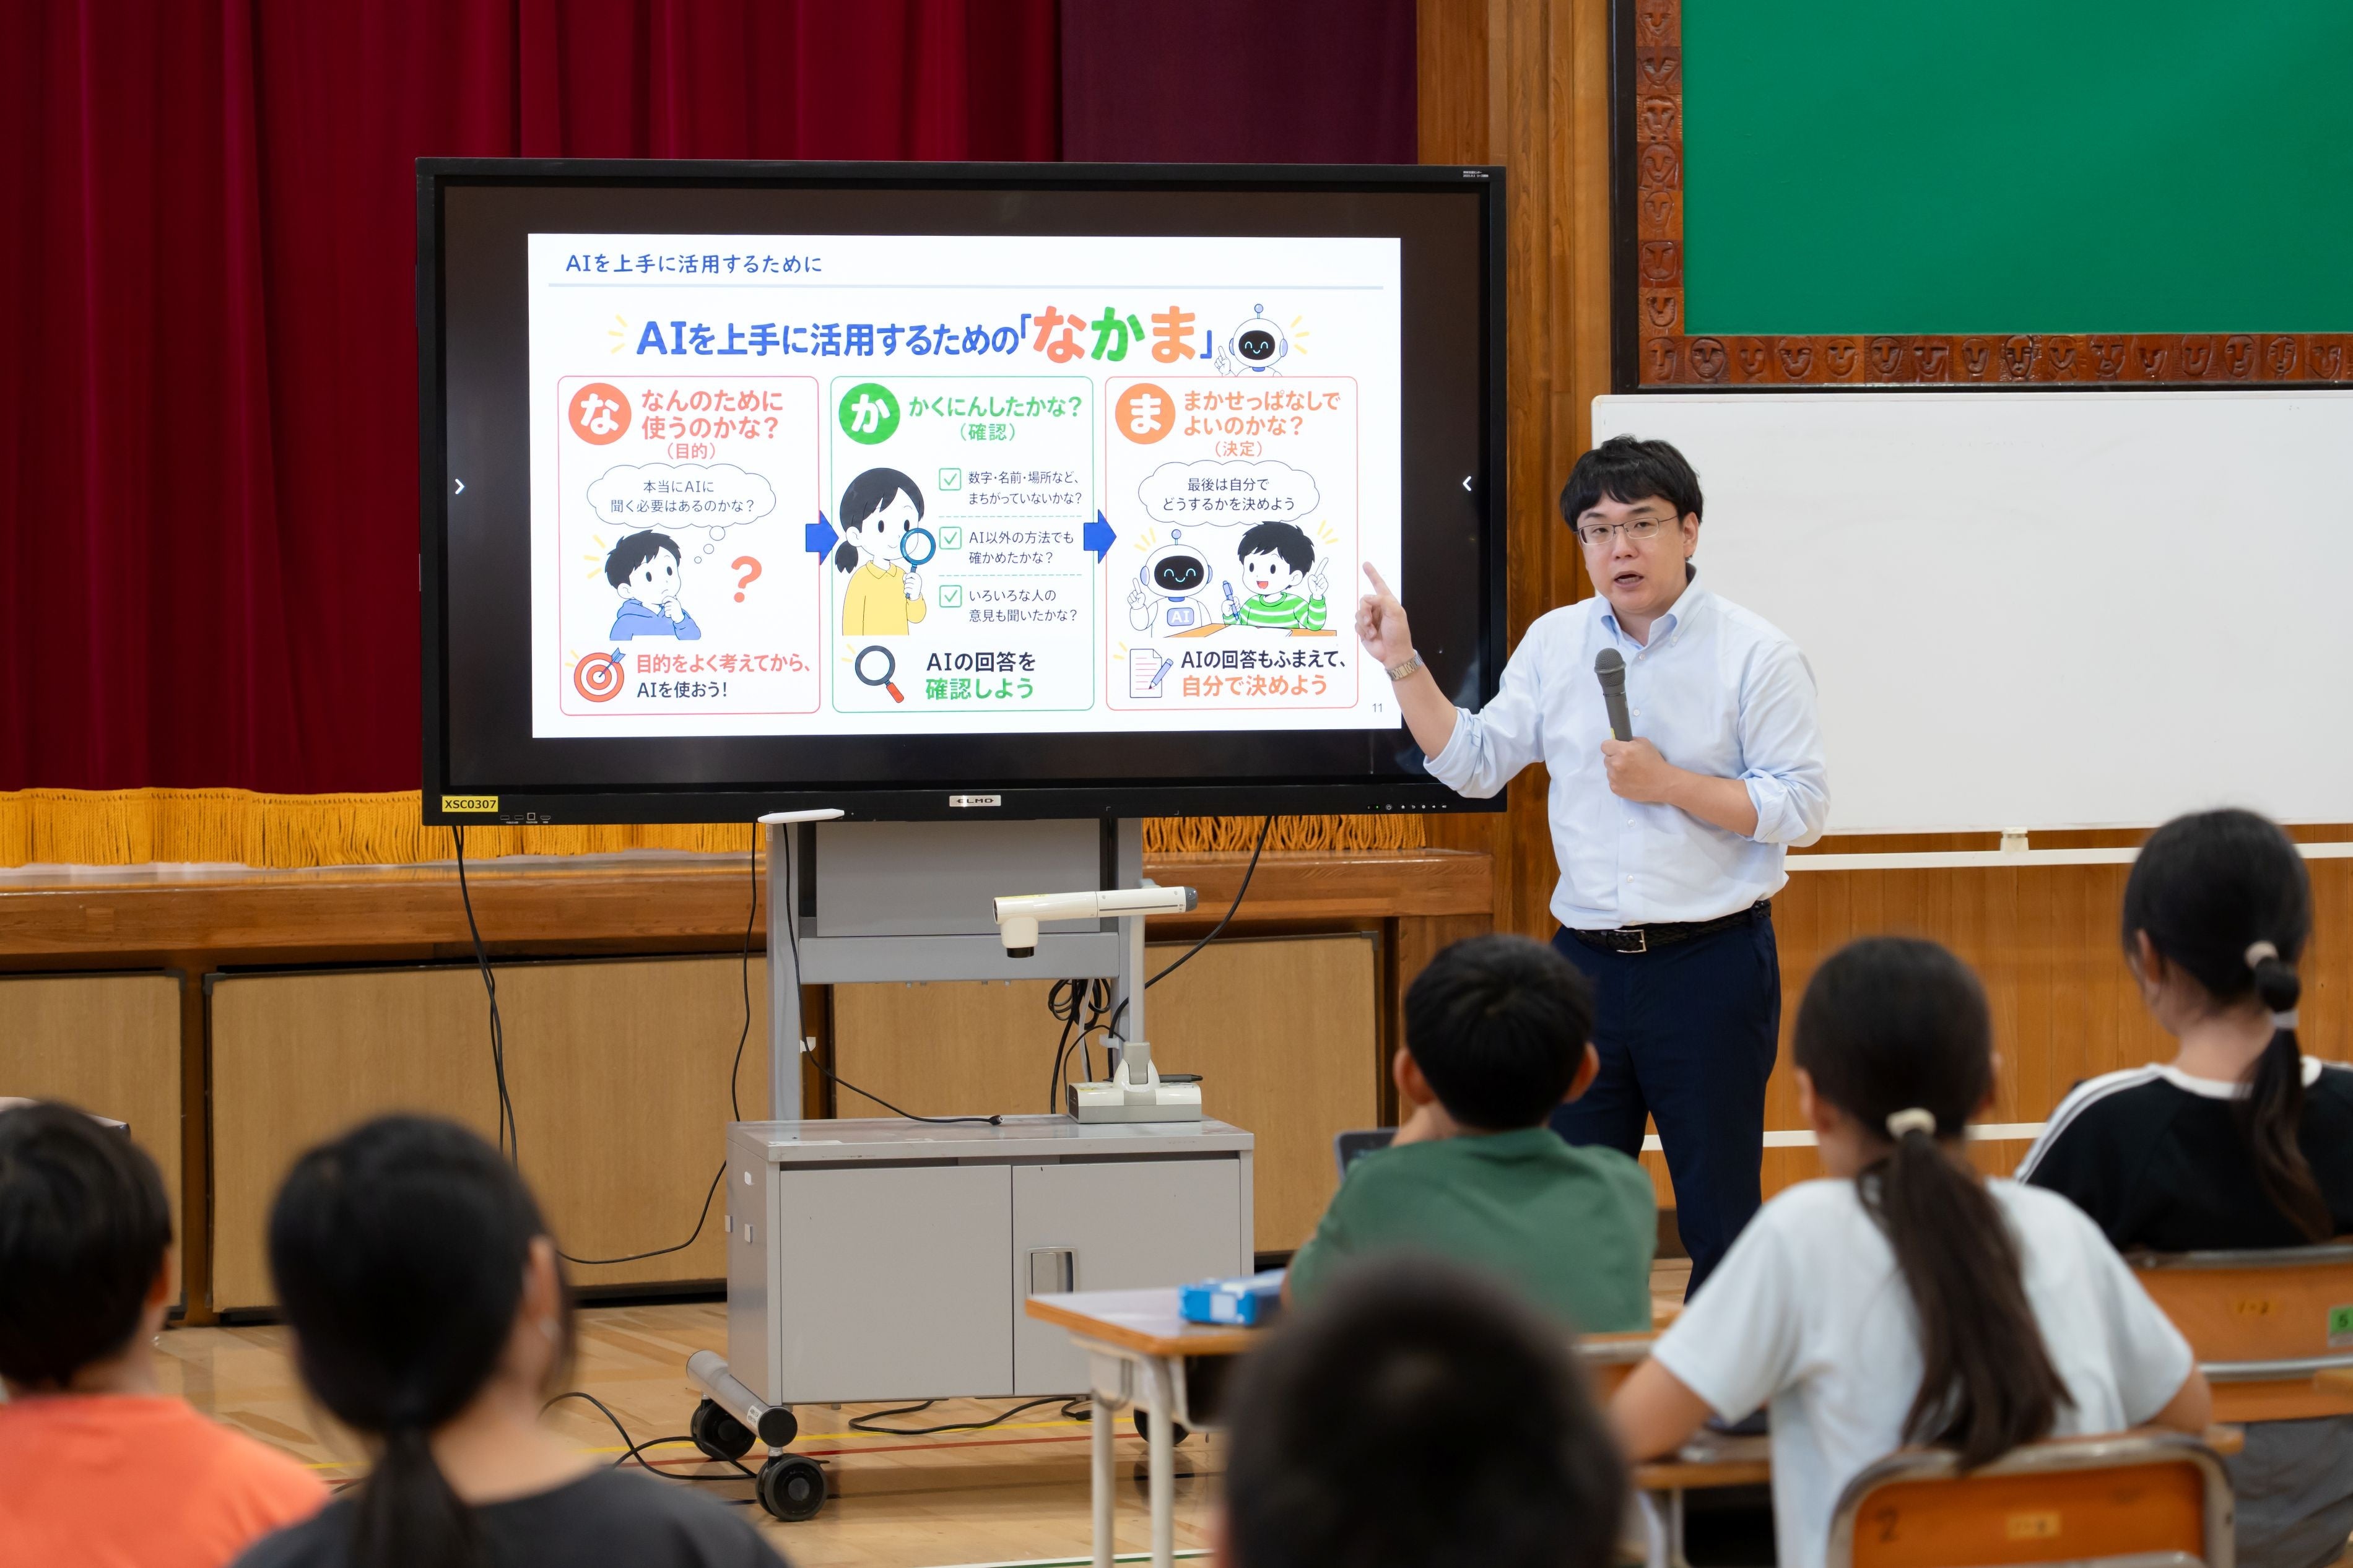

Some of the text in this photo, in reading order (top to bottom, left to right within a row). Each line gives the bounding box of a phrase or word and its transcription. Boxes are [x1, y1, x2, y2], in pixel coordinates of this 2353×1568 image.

[565, 253, 822, 274] AIを上手に活用するために
[642, 389, 783, 412] なんのために
[909, 396, 1082, 417] かくにんしたかな？
[1185, 389, 1341, 411] まかせっぱなしで
[580, 392, 620, 435] な
[850, 393, 890, 434] か
[1129, 393, 1162, 434] ま
[642, 415, 778, 440] 使うのかな？
[1184, 415, 1303, 436] よいのかな？
[643, 480, 714, 493] 本当にAIに
[1187, 477, 1269, 492] 最後は自分で
[611, 500, 754, 513] 聞く必要はあるのかな？
[969, 492, 1082, 505] まちがっていないかな？
[1163, 496, 1294, 511] どうするかを決めよう
[969, 531, 1074, 544] AI以外の方法でも
[968, 551, 1053, 565] 確かめたかな？
[969, 589, 1056, 602] いろいろな人の
[969, 609, 1077, 623] 意見も聞いたかな？
[1171, 610, 1190, 623] AI
[637, 653, 810, 674] 目的をよく考えてから、
[926, 651, 1036, 673] AIの回答を
[1180, 649, 1346, 670] AIの回答もふまえて、
[925, 677, 1033, 701] 確認しよう
[1183, 674, 1327, 697] 自分で決めよう
[1372, 703, 1383, 713] 11
[445, 800, 497, 809] XSC0307
